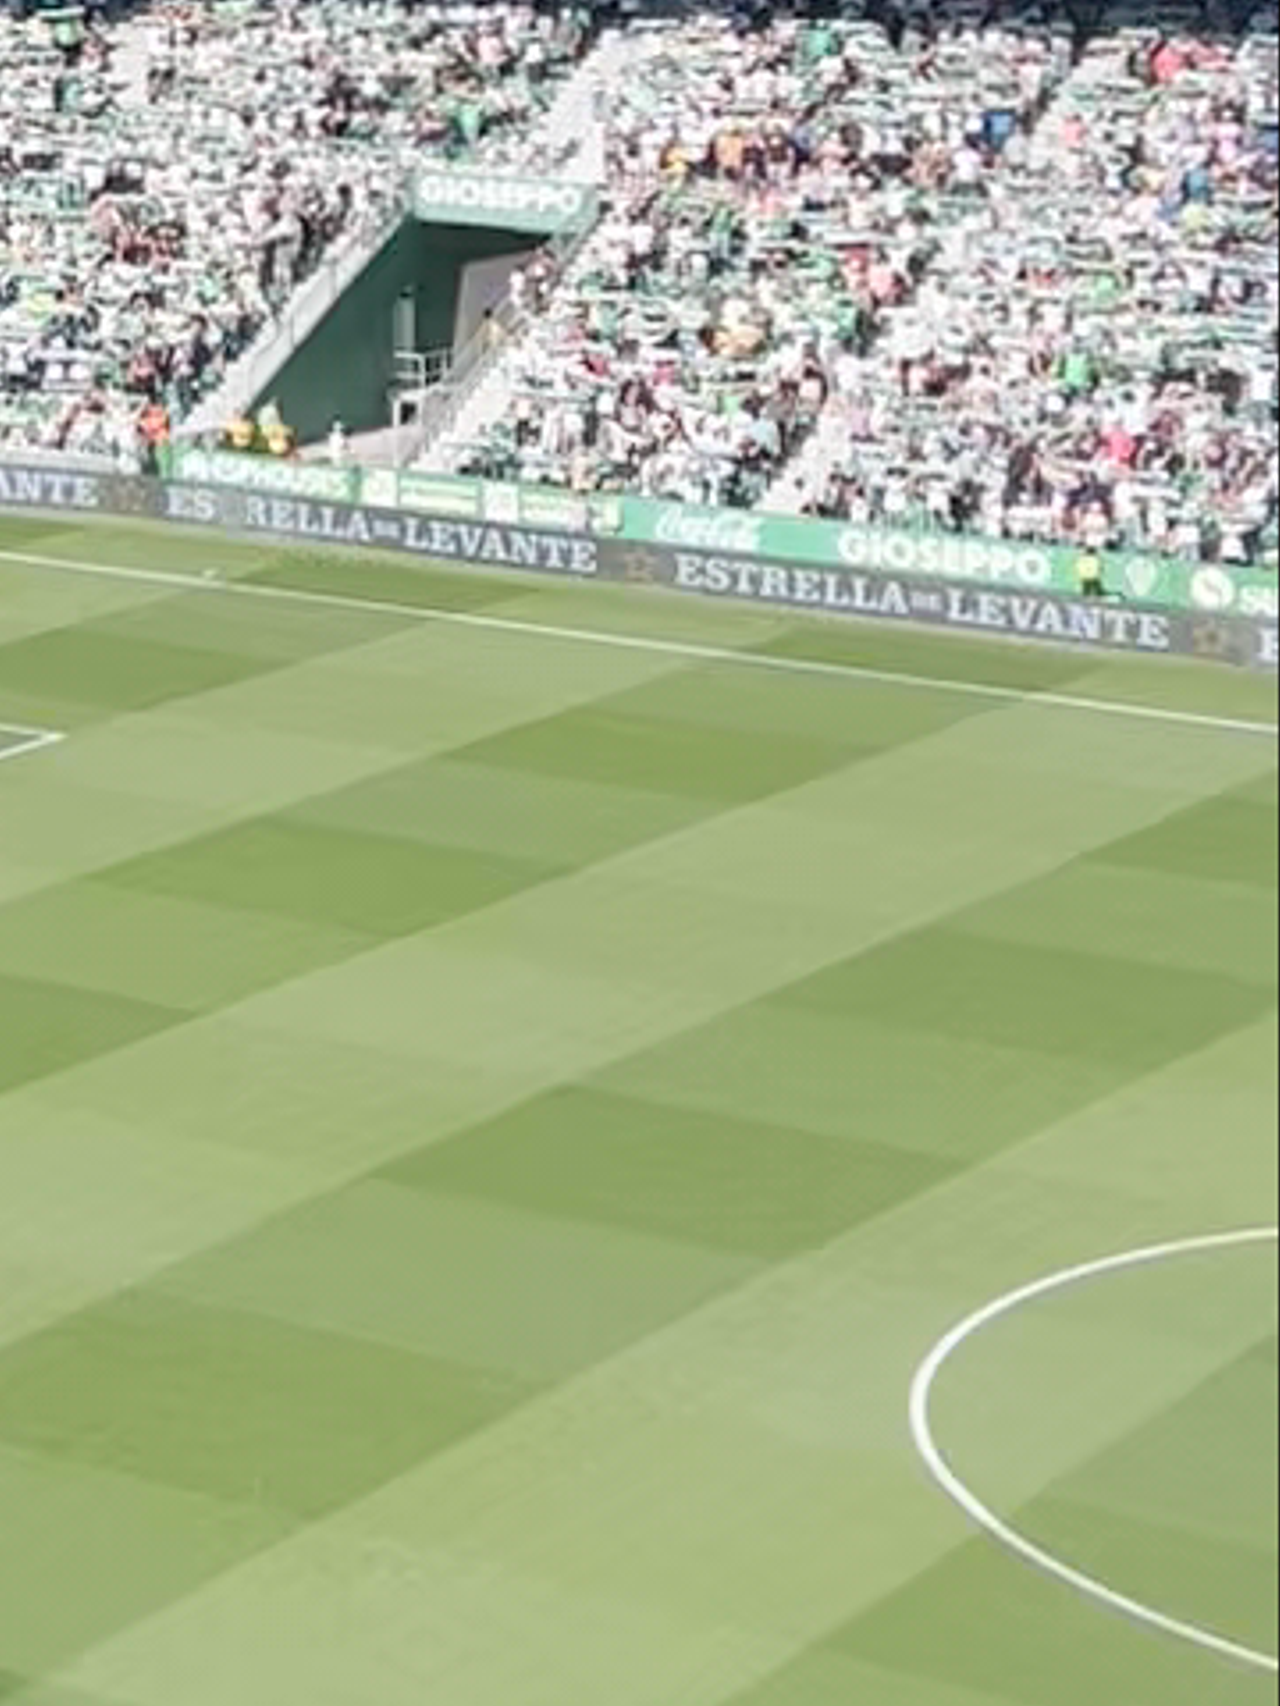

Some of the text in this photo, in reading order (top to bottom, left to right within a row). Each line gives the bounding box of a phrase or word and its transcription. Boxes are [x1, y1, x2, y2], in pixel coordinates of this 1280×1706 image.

[165, 487, 372, 542] ESRELLA
[402, 517, 598, 573] LEVANTE
[838, 529, 1052, 584] GIOSEPPO
[674, 553, 910, 615] ESTRELLA
[947, 591, 1169, 648] LEVANTE
